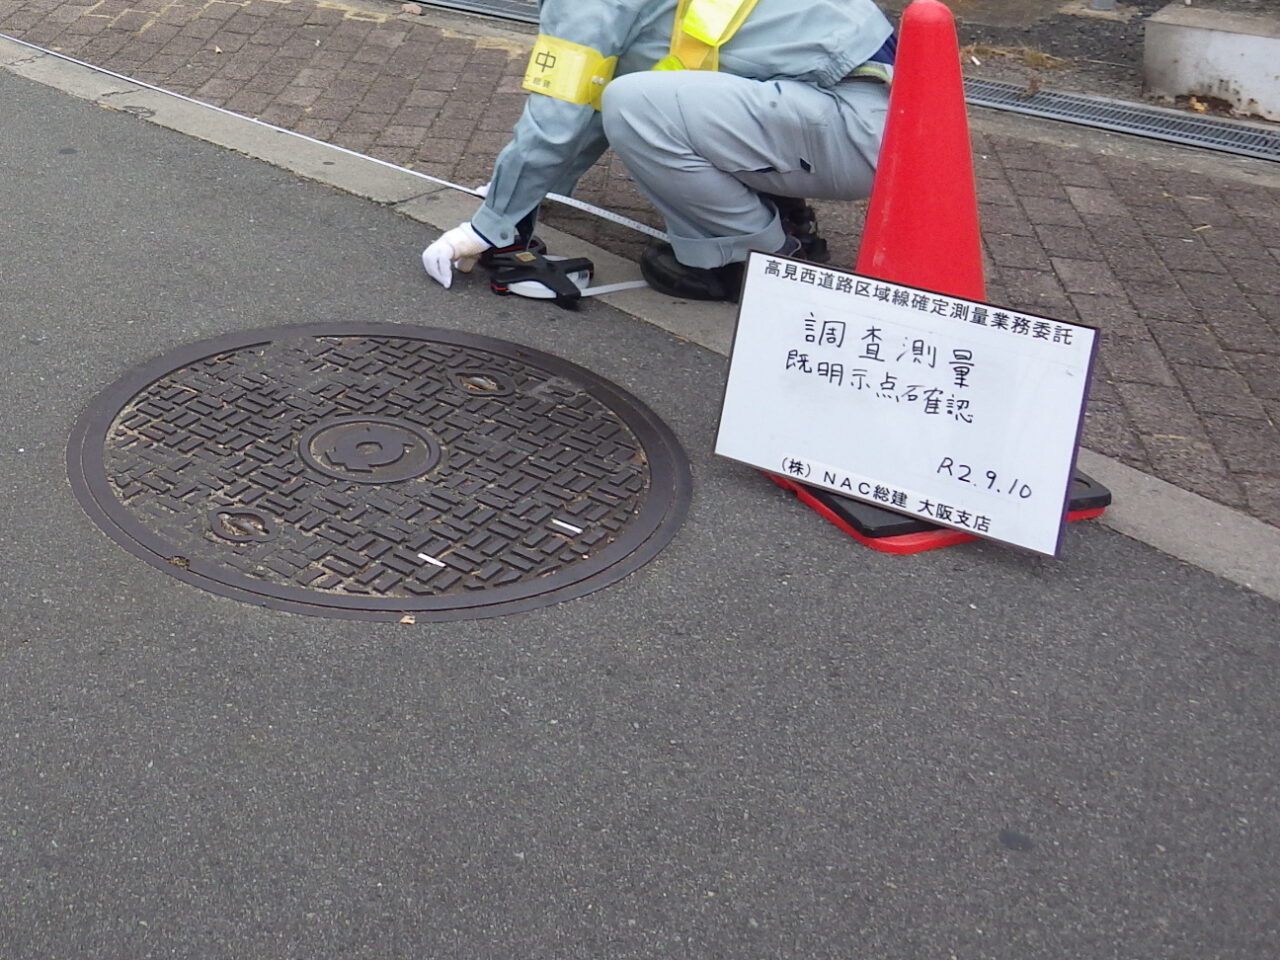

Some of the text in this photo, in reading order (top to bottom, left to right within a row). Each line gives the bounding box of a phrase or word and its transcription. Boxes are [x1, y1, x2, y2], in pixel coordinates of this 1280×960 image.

[535, 51, 556, 72] 中
[765, 259, 1073, 345] 高見西道路区域線確定測量業務委託
[785, 350, 974, 424] 既明示点確認
[917, 499, 992, 533] 大阪支店
